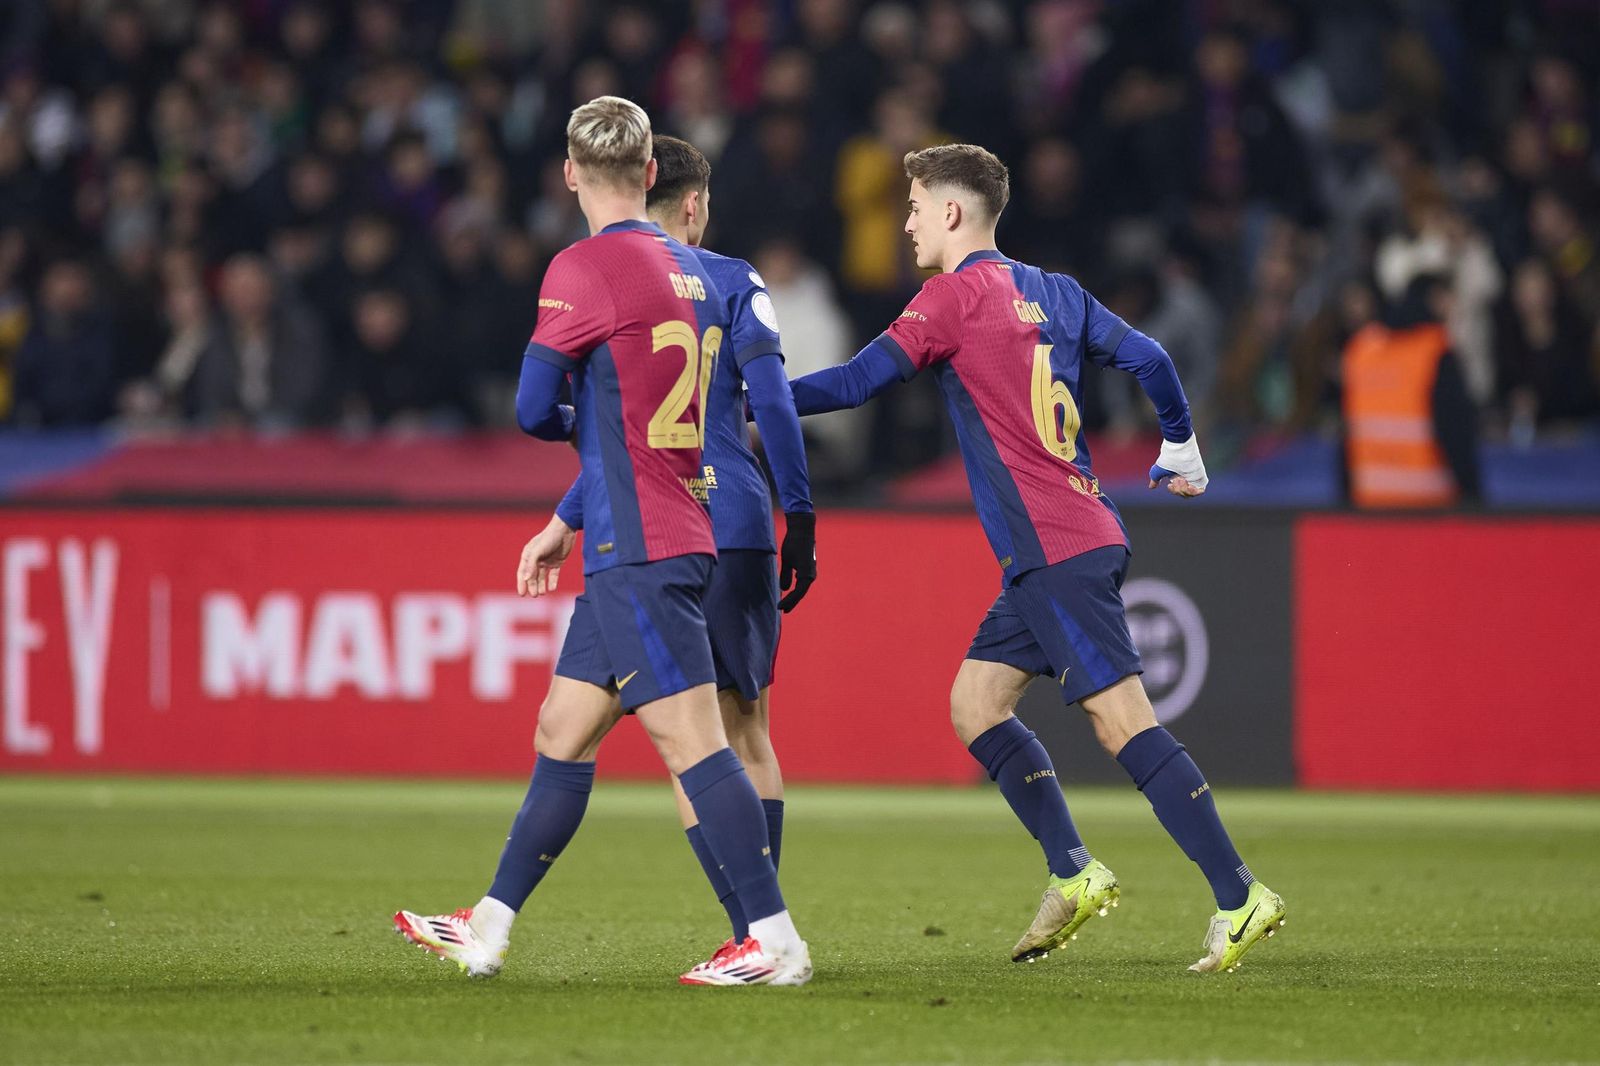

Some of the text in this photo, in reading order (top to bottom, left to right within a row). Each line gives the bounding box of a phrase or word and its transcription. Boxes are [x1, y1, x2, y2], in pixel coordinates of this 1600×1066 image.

[669, 272, 706, 302] OLMO
[1012, 299, 1049, 323] GAVI
[1031, 344, 1081, 463] 6
